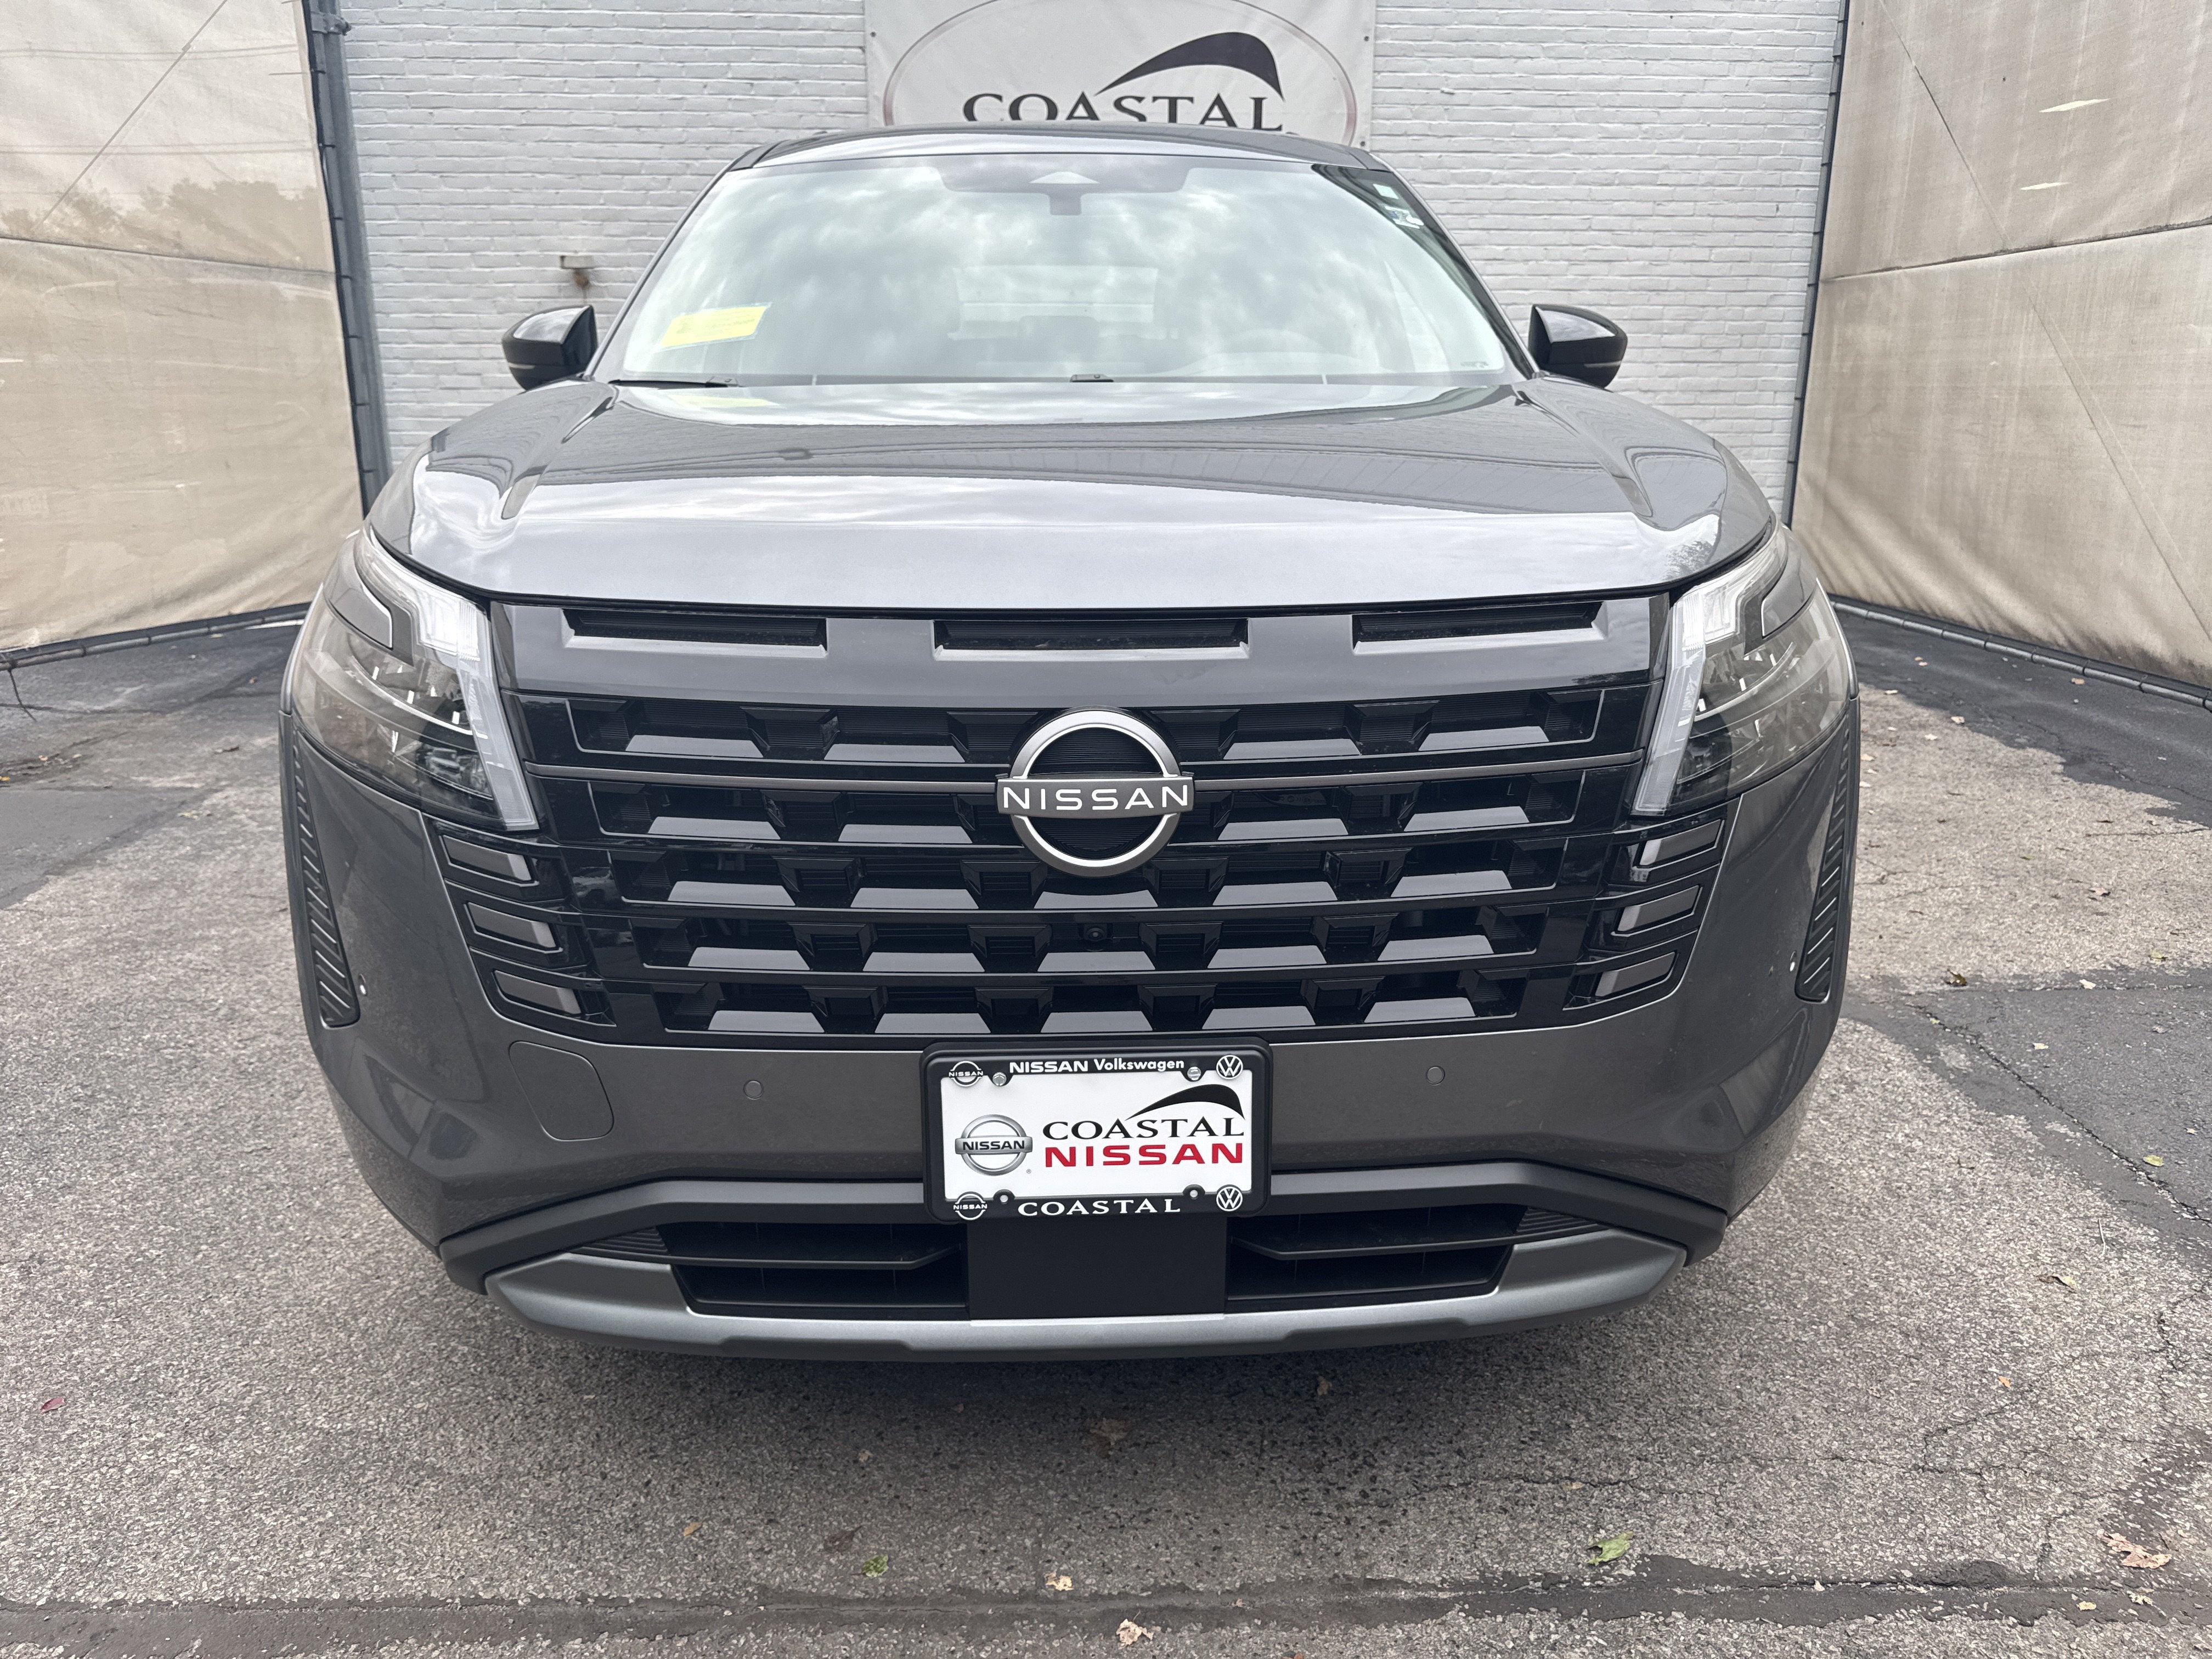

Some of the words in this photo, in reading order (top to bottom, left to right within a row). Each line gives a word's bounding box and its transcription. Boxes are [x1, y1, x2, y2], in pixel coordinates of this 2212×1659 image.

[963, 92, 1283, 131] COASTAL
[1003, 785, 1187, 810] NISSAN
[1009, 1060, 1088, 1073] NISSAN
[1094, 1058, 1184, 1071] Volkswagen
[1042, 1116, 1244, 1140] COASTAL
[963, 1139, 1025, 1151] NISSAN
[1045, 1143, 1243, 1167] NISSAN
[1018, 1198, 1181, 1216] COASTAL
